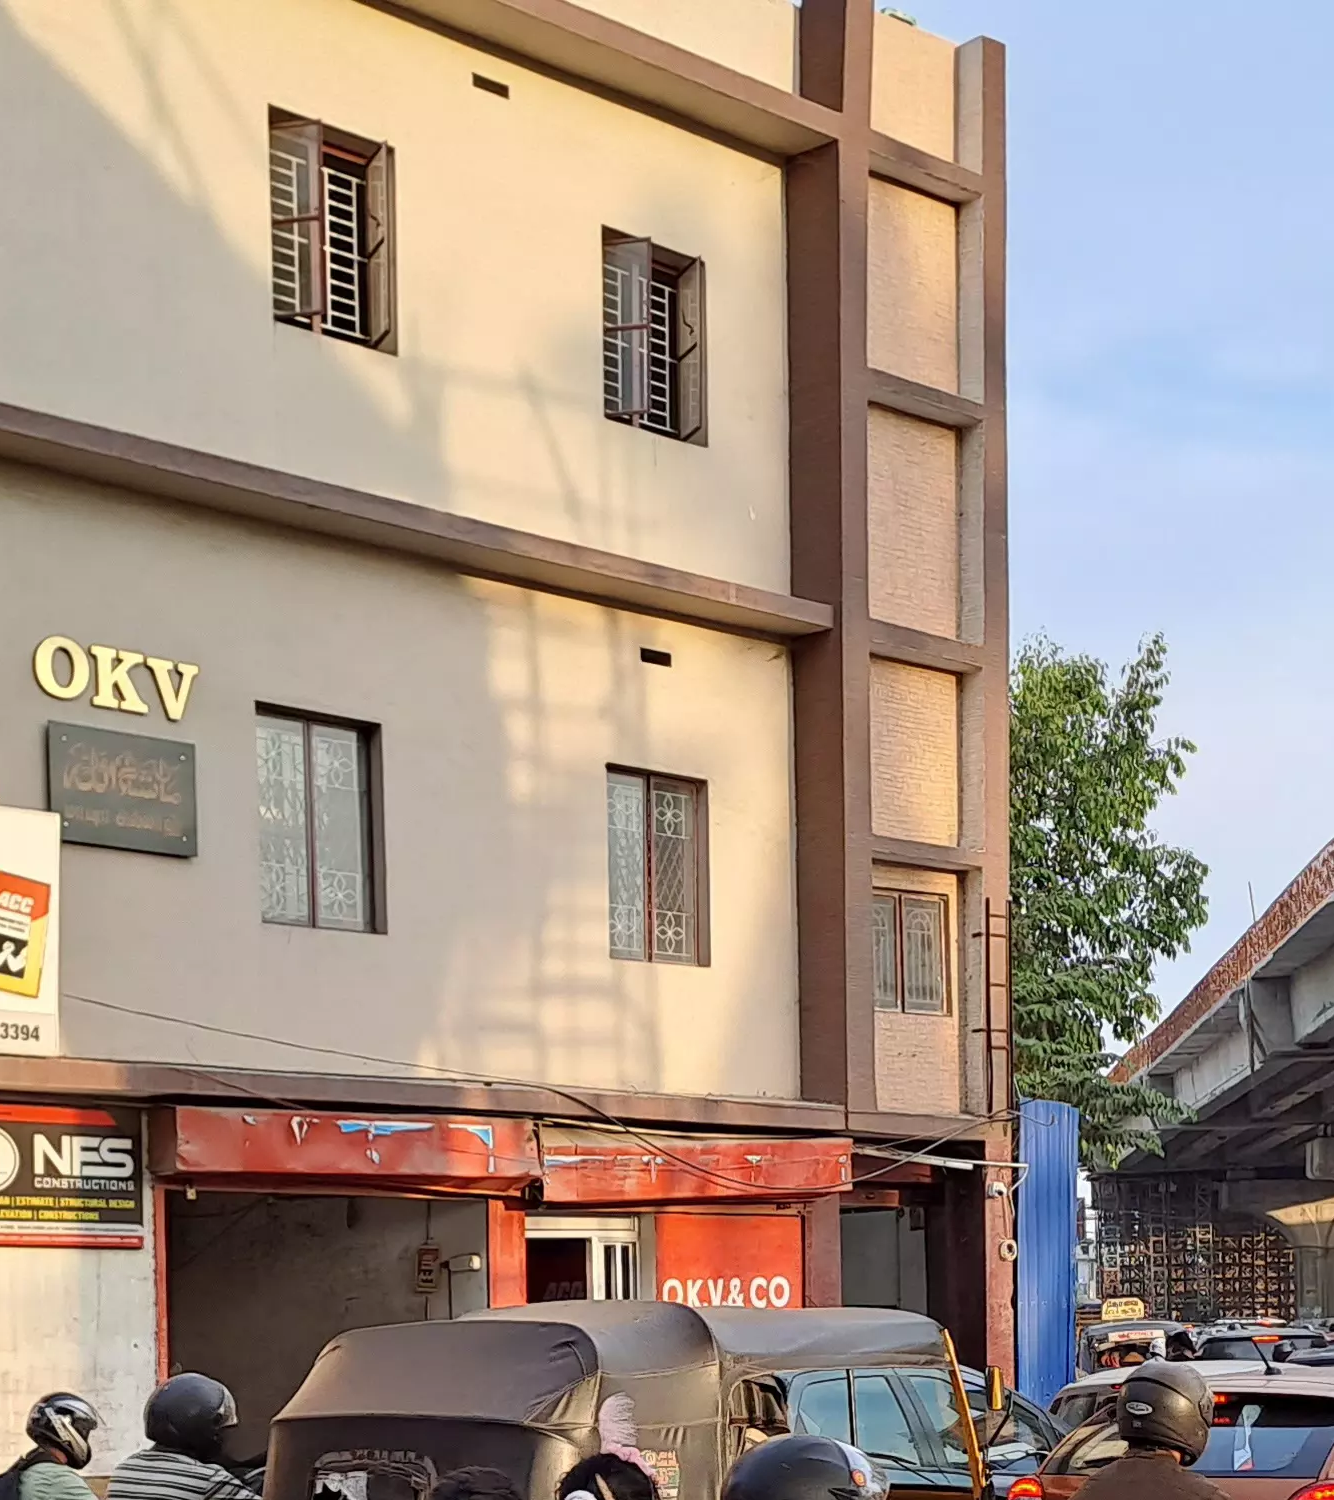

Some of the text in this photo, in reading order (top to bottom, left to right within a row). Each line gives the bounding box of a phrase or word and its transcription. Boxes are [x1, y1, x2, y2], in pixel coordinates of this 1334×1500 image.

[33, 635, 199, 722] OKV
[32, 1133, 134, 1178] NFS
[34, 1177, 134, 1191] CONSTRUCTIONS
